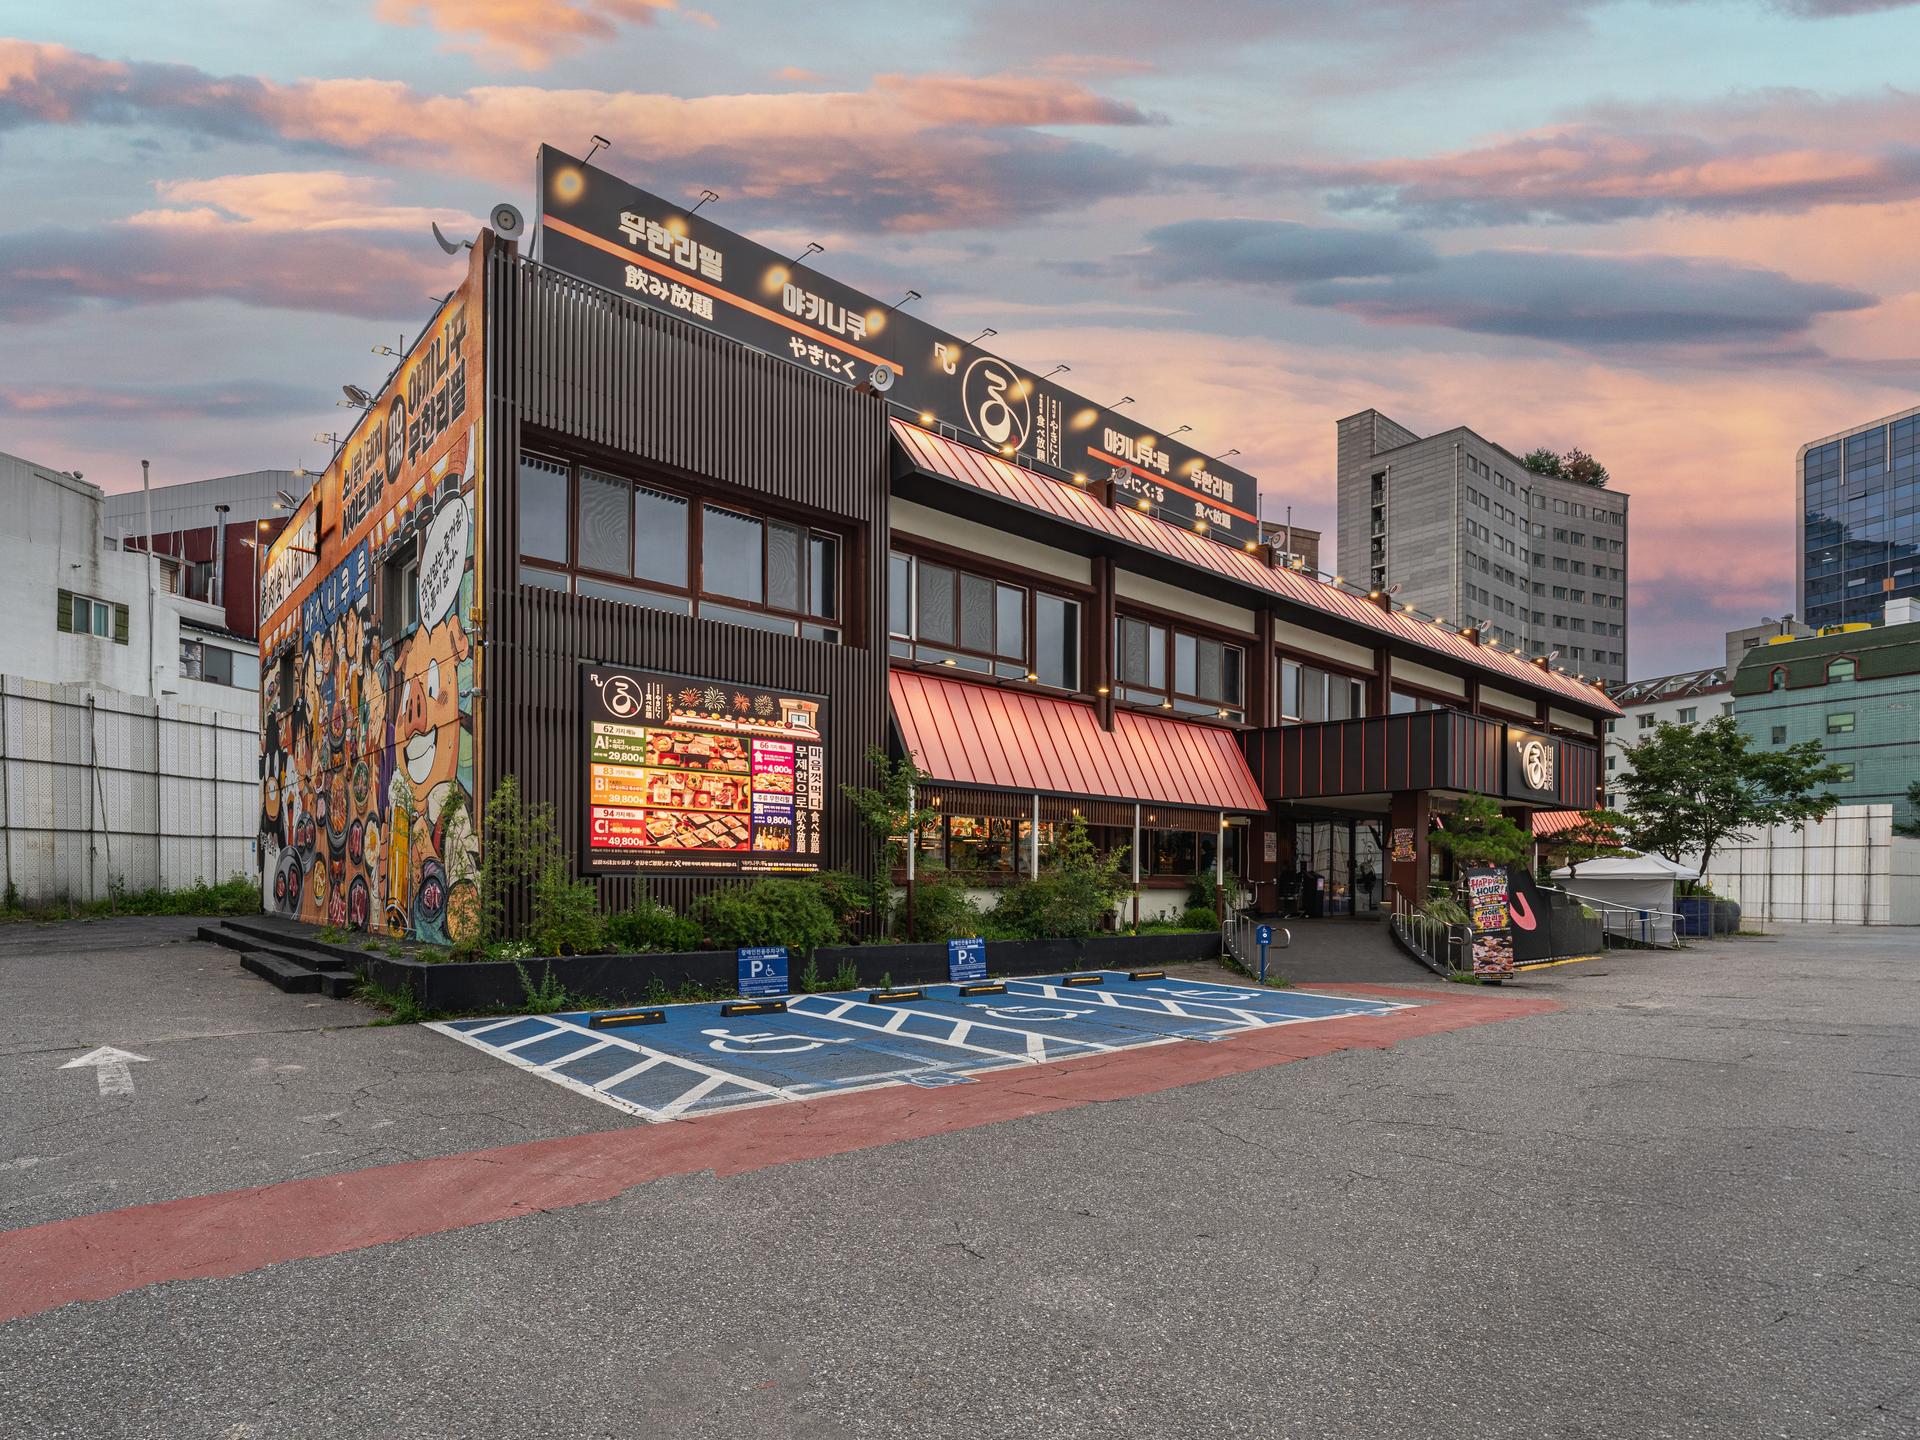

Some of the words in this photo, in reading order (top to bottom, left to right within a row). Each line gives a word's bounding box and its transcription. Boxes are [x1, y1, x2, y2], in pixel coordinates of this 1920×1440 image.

[618, 212, 722, 282] 무한리필
[783, 283, 867, 341] 야키니쿠
[625, 265, 713, 321] 飲み放題
[789, 336, 856, 380] やきにく
[407, 357, 467, 467] 무한리필
[1049, 419, 1059, 466] やきにく
[1190, 465, 1233, 503] 무한리필
[1194, 502, 1231, 530] 食べ放題
[603, 725, 614, 735] 62
[759, 741, 770, 750] 66
[602, 767, 614, 775] 83
[795, 745, 808, 808] 무제한으로
[810, 747, 822, 809] 마음껏먹다
[603, 809, 614, 818] 94
[796, 810, 807, 853] 飲み放題
[810, 811, 820, 854] 食べ放題
[1470, 877, 1498, 891] HAPPY
[1475, 884, 1505, 896] HOUR!
[751, 960, 763, 978] P
[958, 949, 968, 965] P
